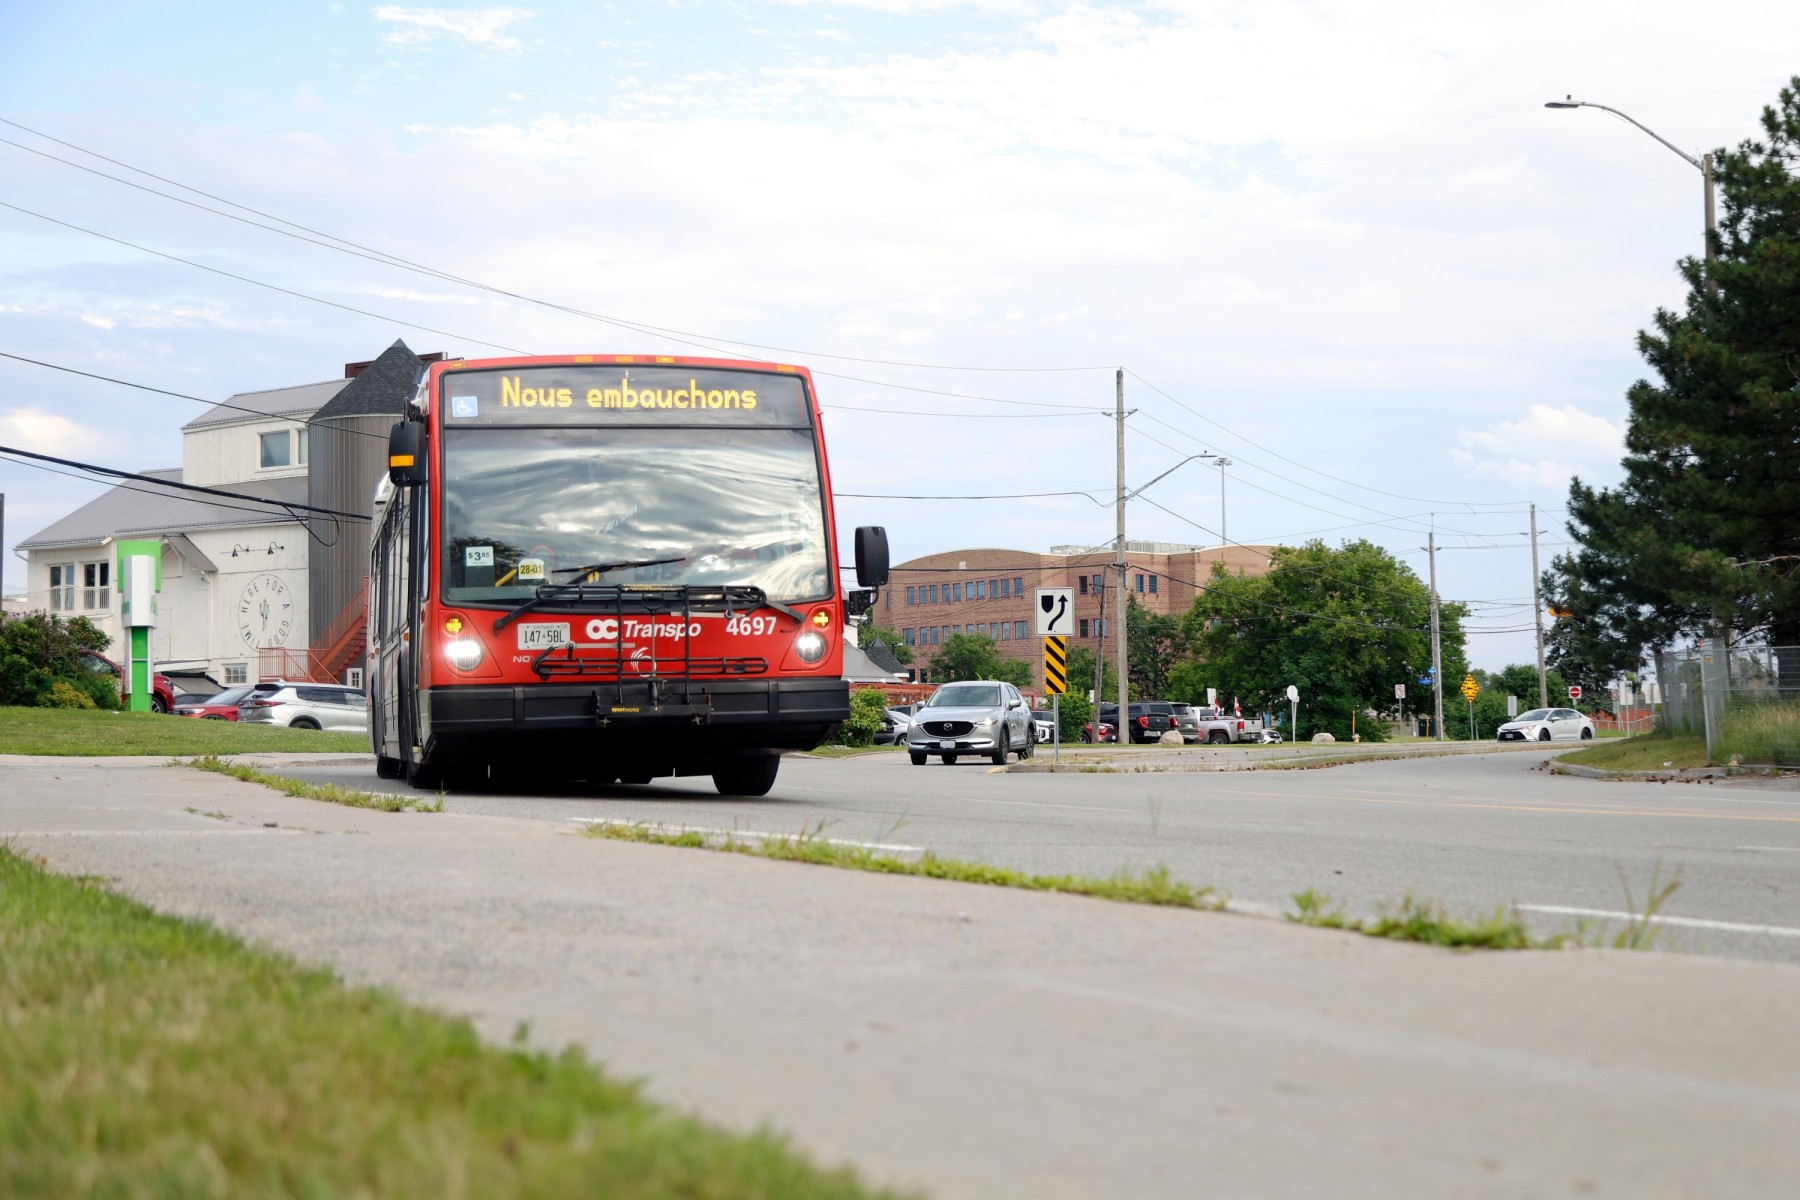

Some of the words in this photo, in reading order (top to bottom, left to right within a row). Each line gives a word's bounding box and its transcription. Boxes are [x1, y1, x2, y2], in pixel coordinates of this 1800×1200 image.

[502, 377, 573, 408] Nous
[587, 378, 758, 410] embauchons
[520, 565, 542, 574] 28-01
[240, 582, 260, 613] HERE
[266, 578, 284, 597] FOR
[241, 622, 260, 649] TIME
[268, 620, 290, 649] GOOD
[524, 630, 541, 643] 147
[547, 630, 565, 642] 5BL
[623, 620, 702, 641] Transpo
[726, 616, 777, 636] 4697
